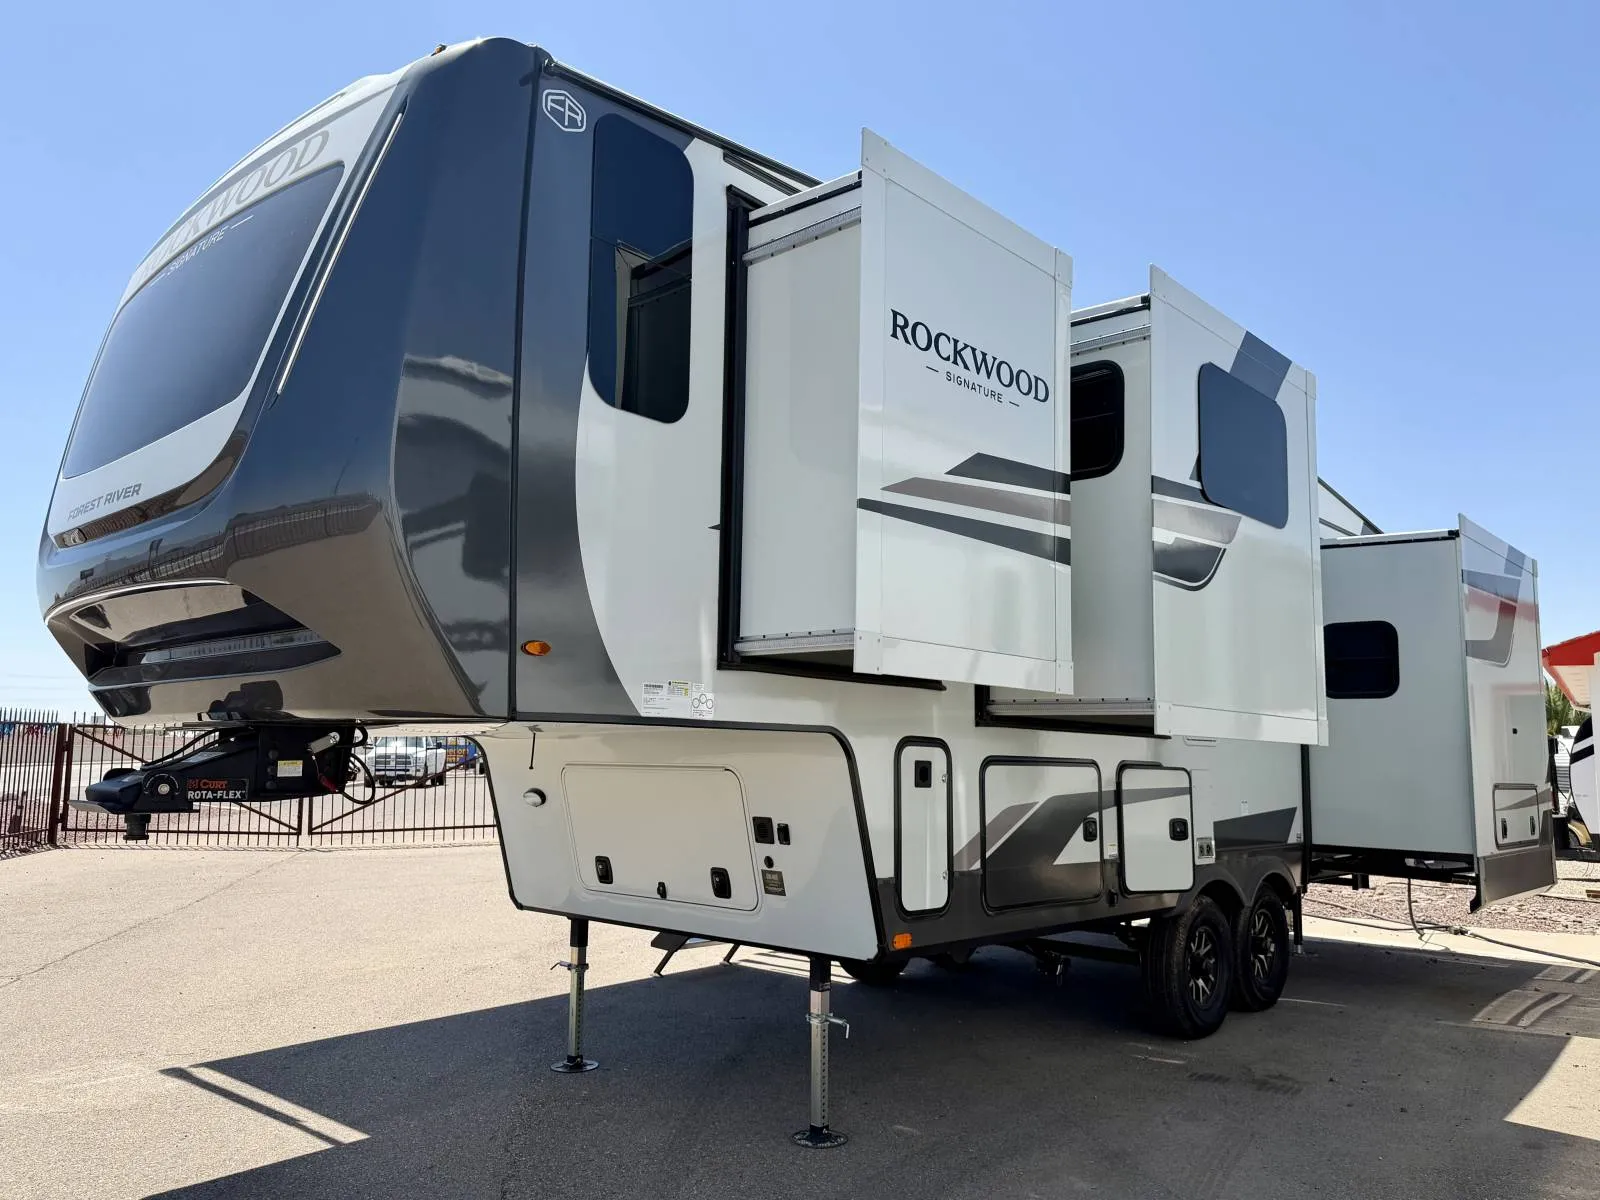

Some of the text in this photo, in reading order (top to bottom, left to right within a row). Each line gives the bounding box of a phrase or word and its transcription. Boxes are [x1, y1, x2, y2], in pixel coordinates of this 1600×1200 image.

[139, 129, 330, 285] KWOOD
[167, 226, 229, 275] SIGNATURE
[889, 307, 1050, 403] ROCKWOOD
[945, 370, 1003, 404] SIGNATURE
[67, 482, 142, 521] FOREST RIVER
